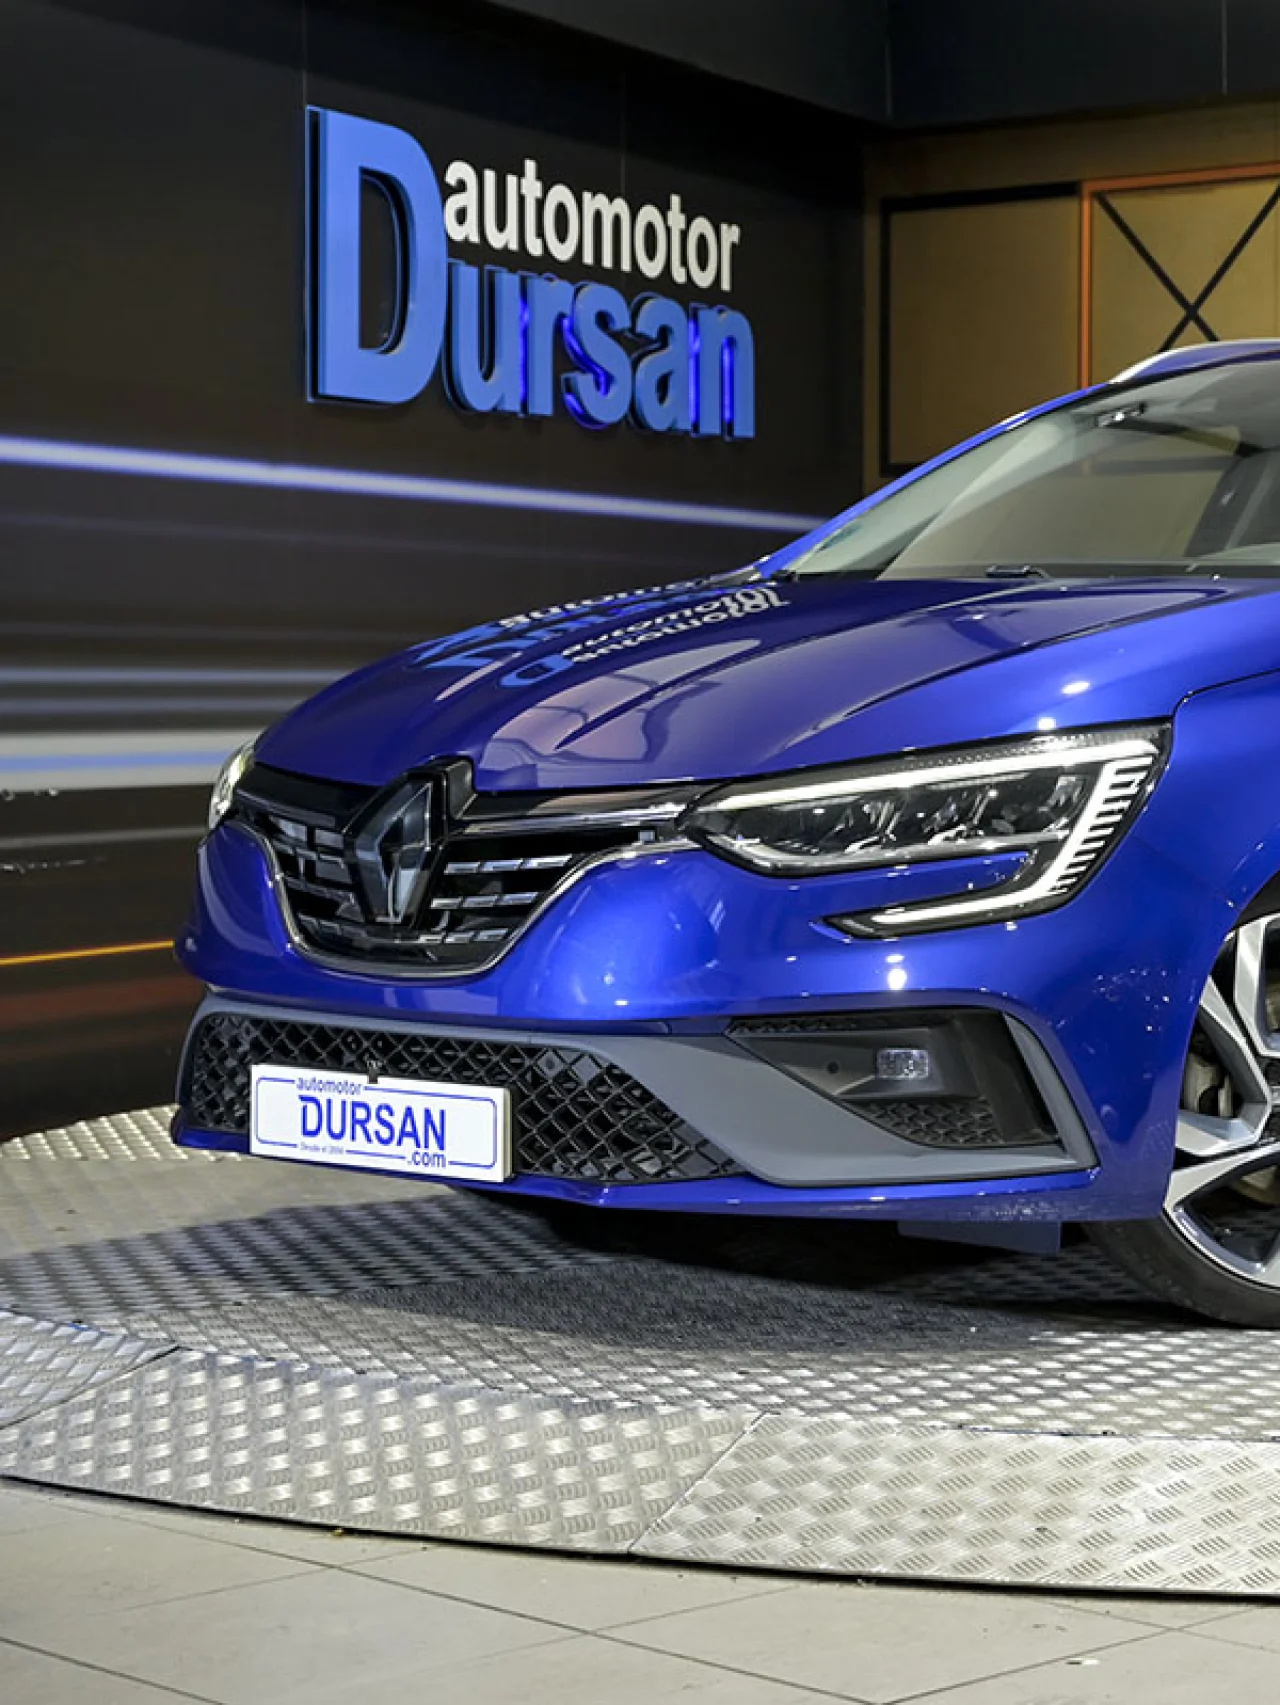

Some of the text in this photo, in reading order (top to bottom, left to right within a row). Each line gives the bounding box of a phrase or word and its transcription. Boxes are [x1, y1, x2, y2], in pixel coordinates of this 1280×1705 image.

[443, 157, 741, 292] automotor
[306, 104, 756, 441] Dursan
[296, 1077, 362, 1096] automotor
[298, 1095, 447, 1151] DURSAN
